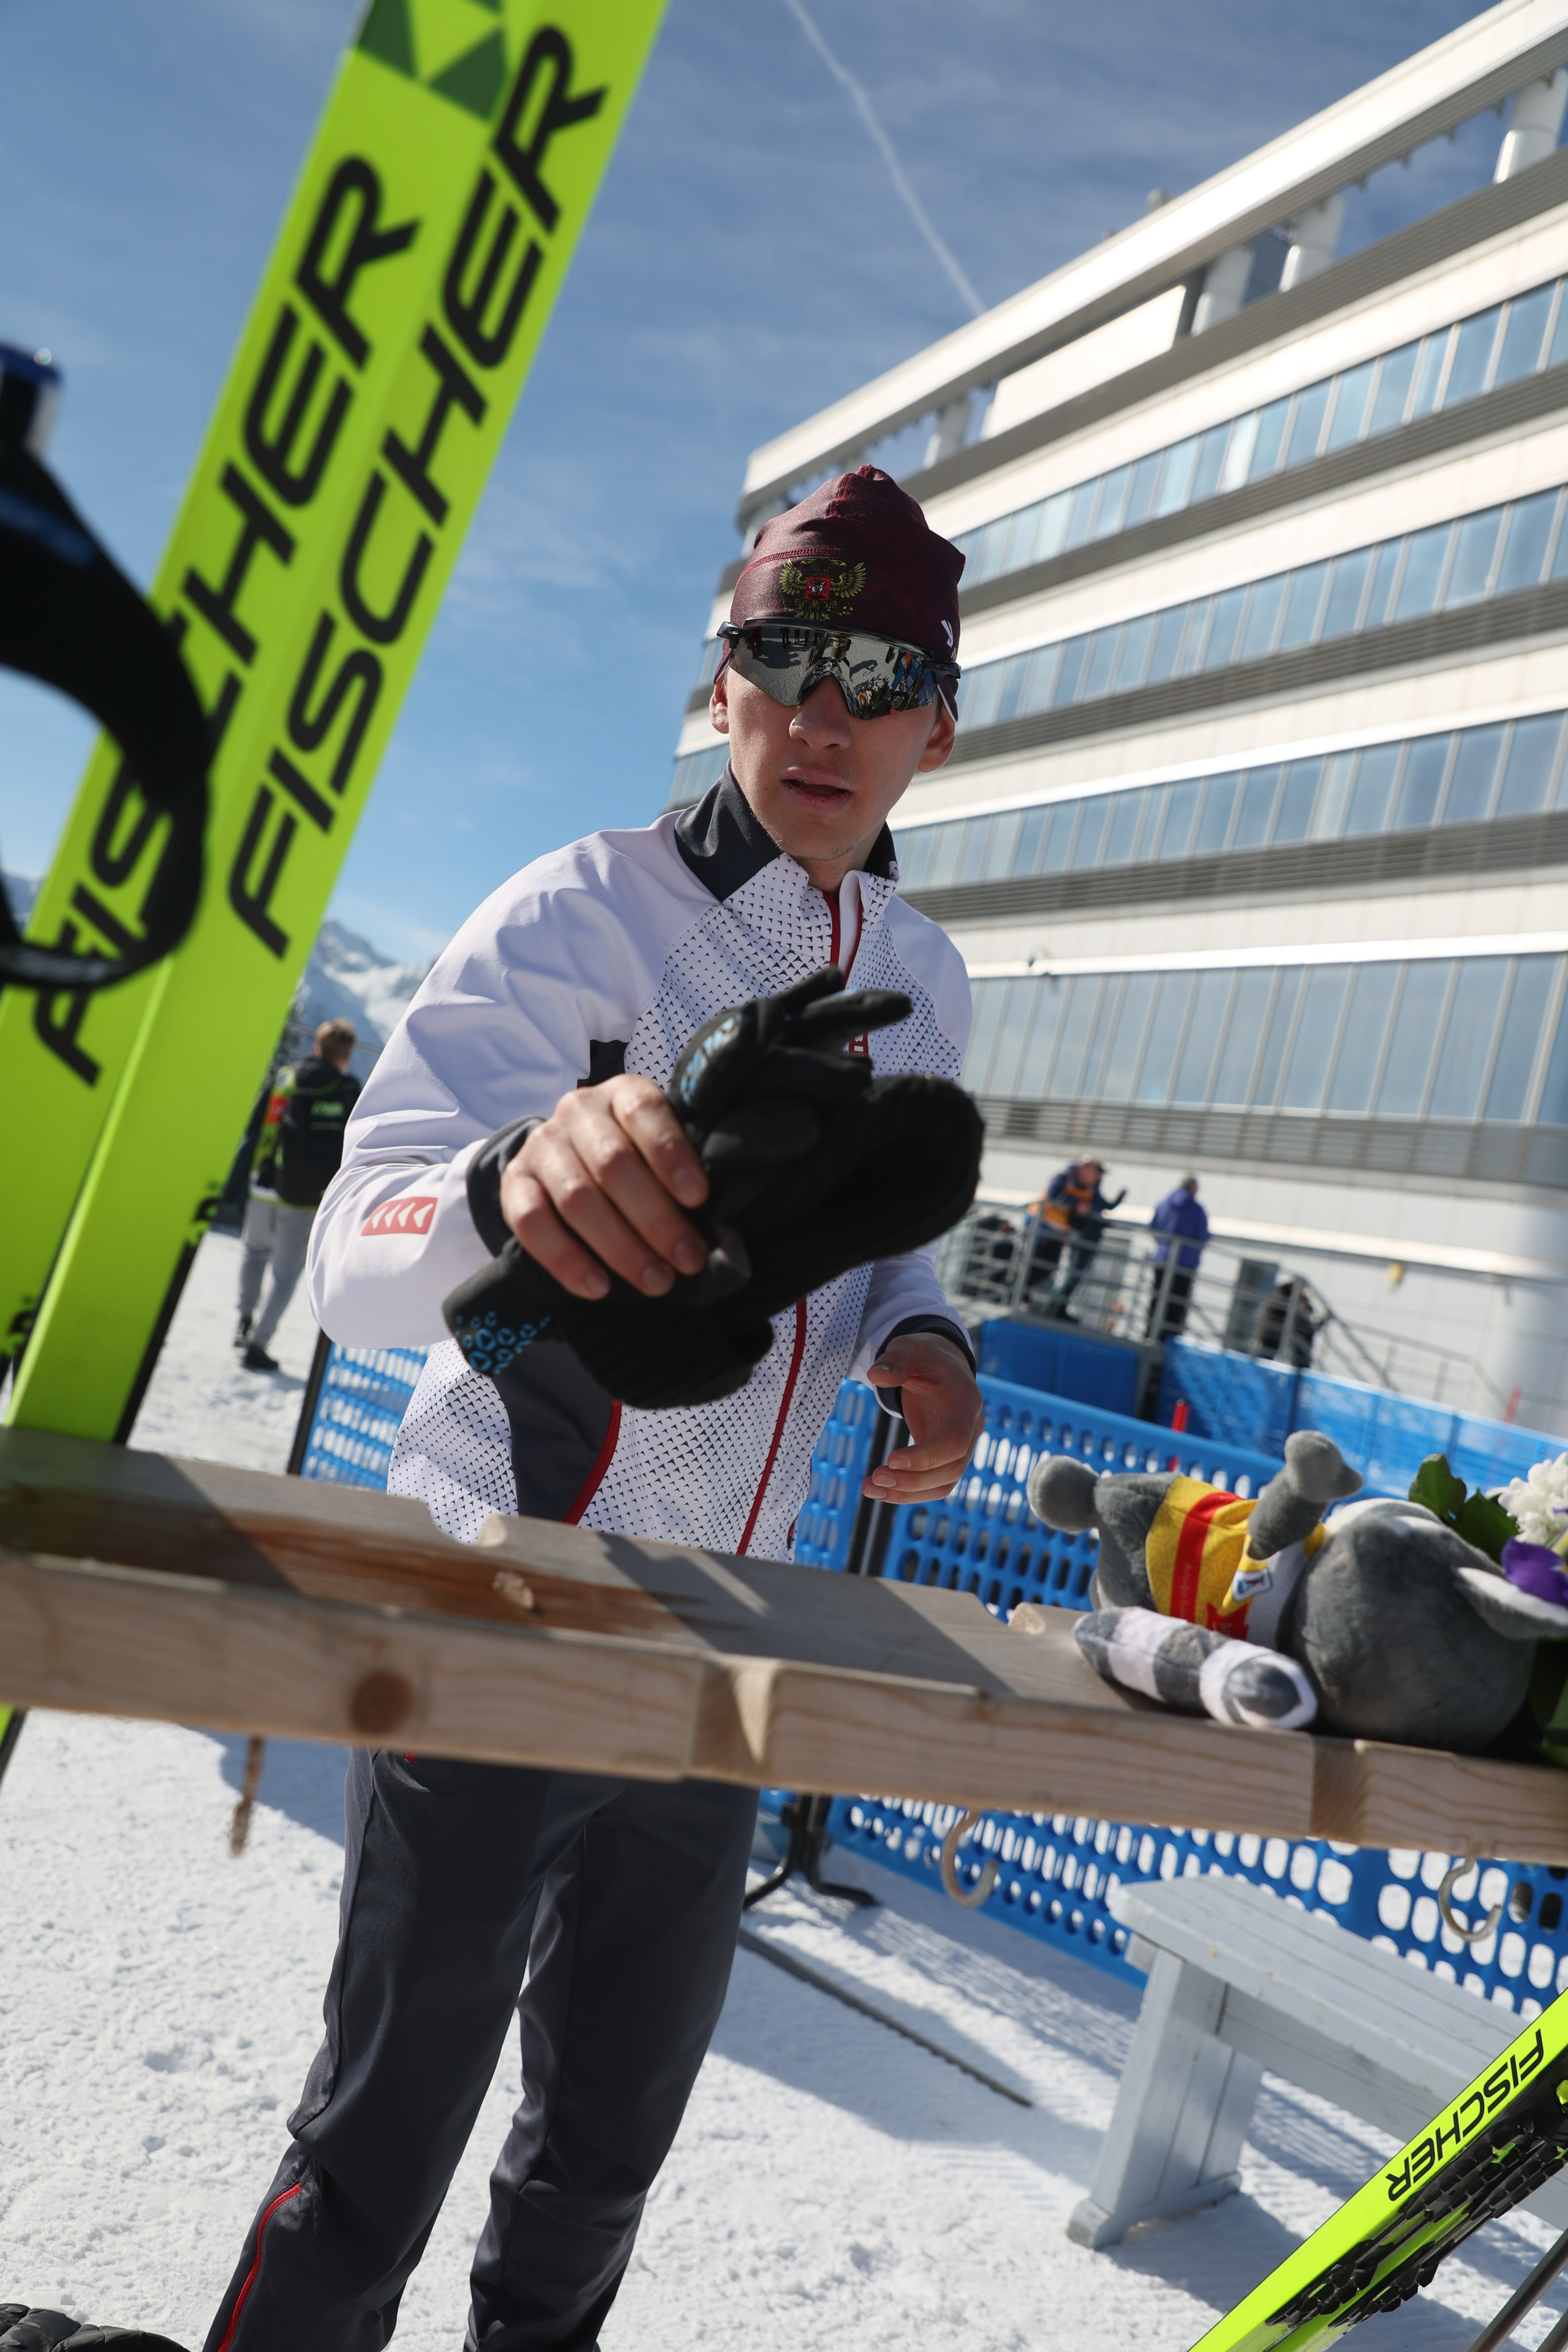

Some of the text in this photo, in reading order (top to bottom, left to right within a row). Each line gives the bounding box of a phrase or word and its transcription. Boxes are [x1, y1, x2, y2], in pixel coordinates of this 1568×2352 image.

[32, 154, 421, 1088] FISHER
[226, 24, 608, 959] FISCHER
[1385, 2028, 1544, 2201] FISCHER
